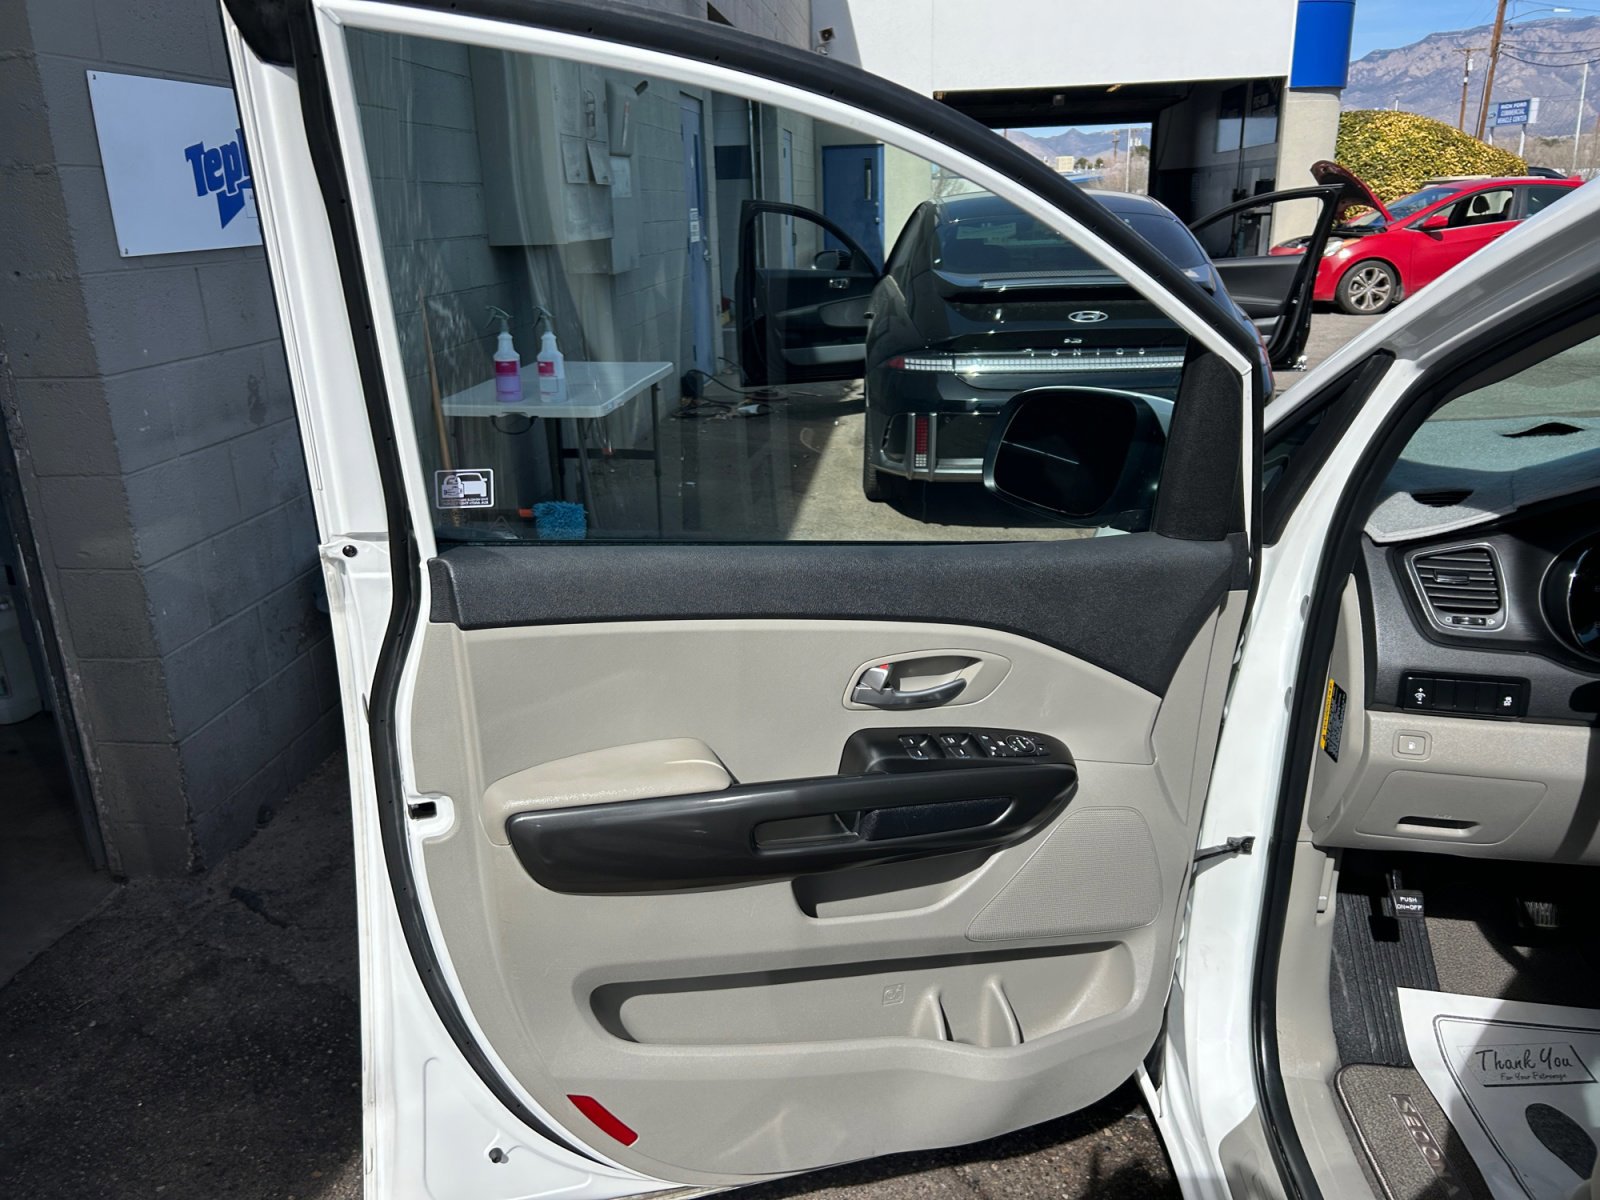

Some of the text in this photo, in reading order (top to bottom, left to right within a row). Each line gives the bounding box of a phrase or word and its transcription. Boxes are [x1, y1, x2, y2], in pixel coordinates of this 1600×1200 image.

[1475, 1047, 1573, 1071] Thank You
[1500, 1072, 1513, 1080] For
[1515, 1071, 1530, 1080] Your
